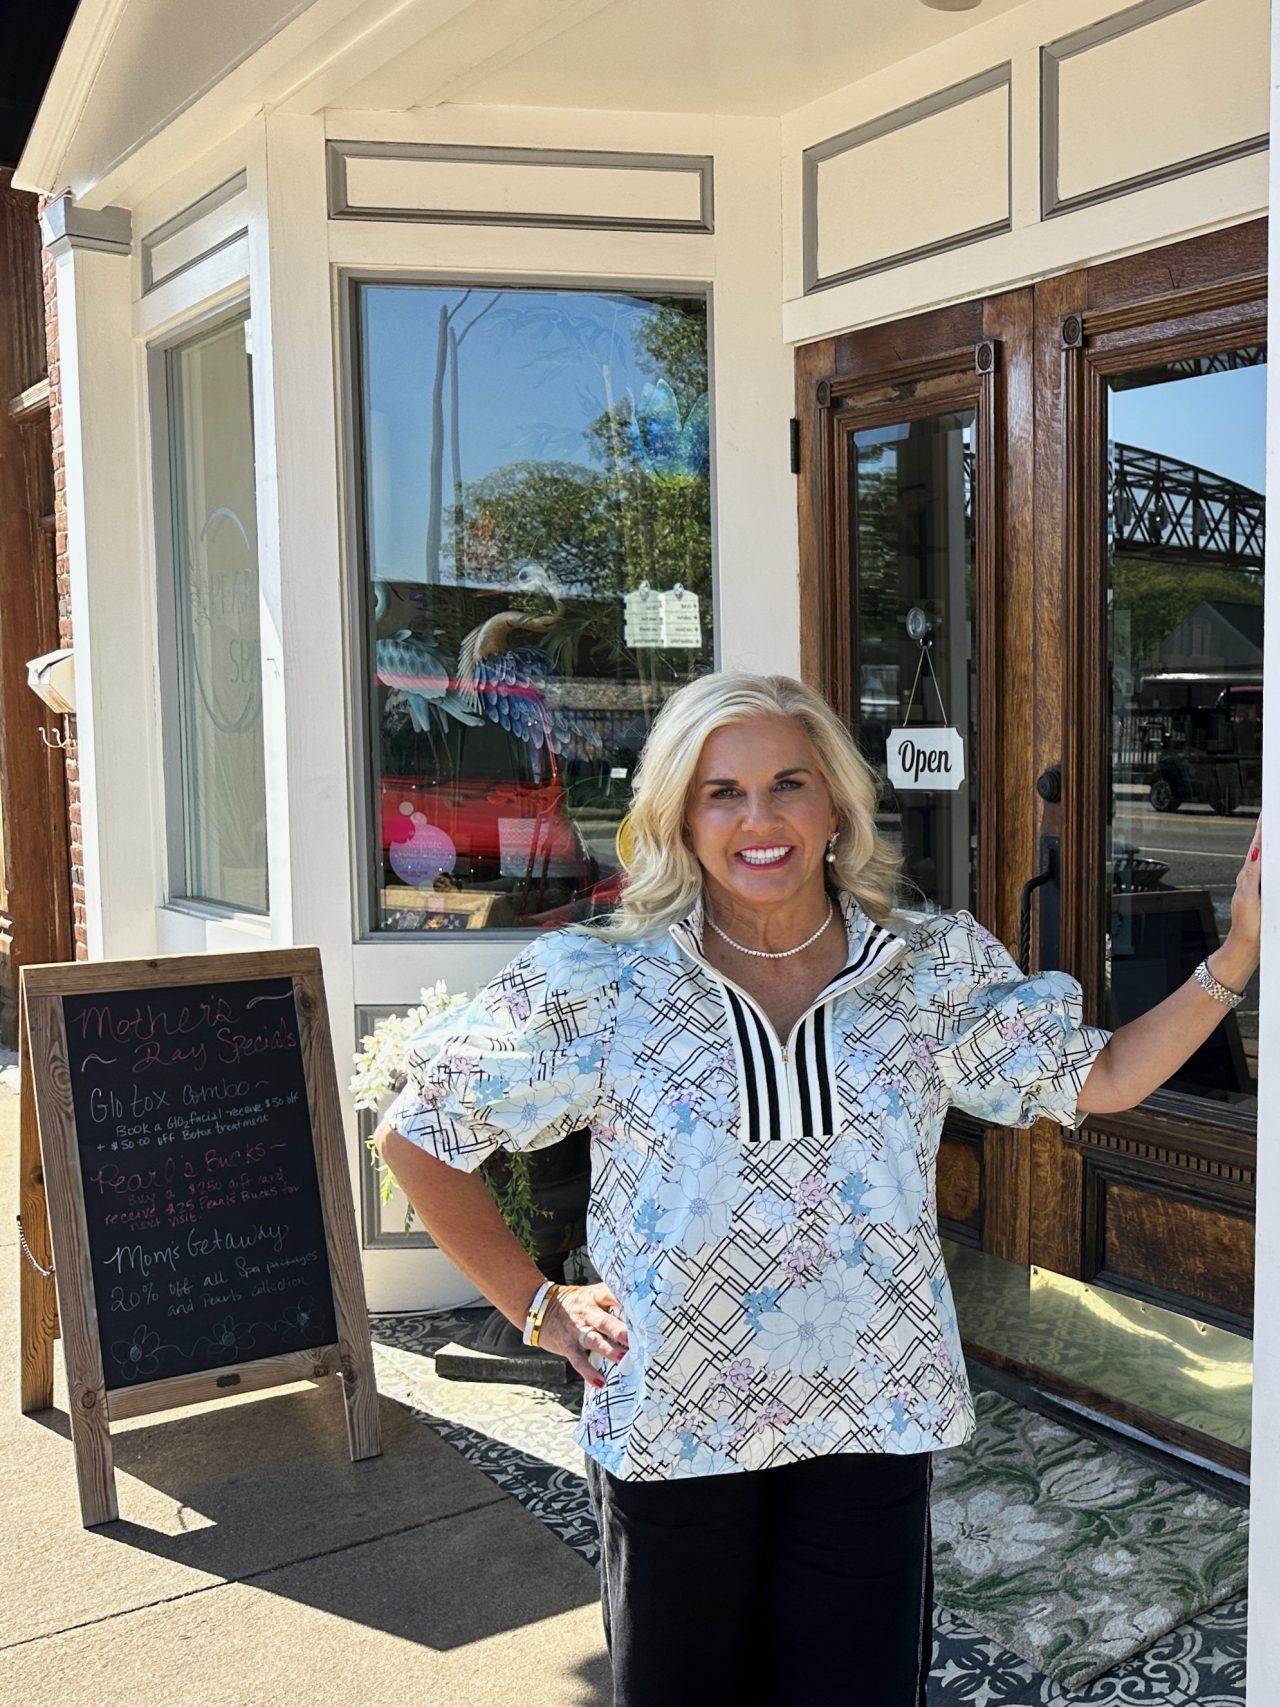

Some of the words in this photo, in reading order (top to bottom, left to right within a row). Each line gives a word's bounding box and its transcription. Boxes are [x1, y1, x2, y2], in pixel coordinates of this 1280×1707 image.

[898, 739, 953, 784] Open
[72, 995, 240, 1044] Mother's
[217, 1017, 297, 1064] Specials
[104, 1239, 180, 1277] Mom's
[187, 1224, 289, 1257] Getaway
[111, 1284, 160, 1313] 20%
[167, 1299, 195, 1318] and
